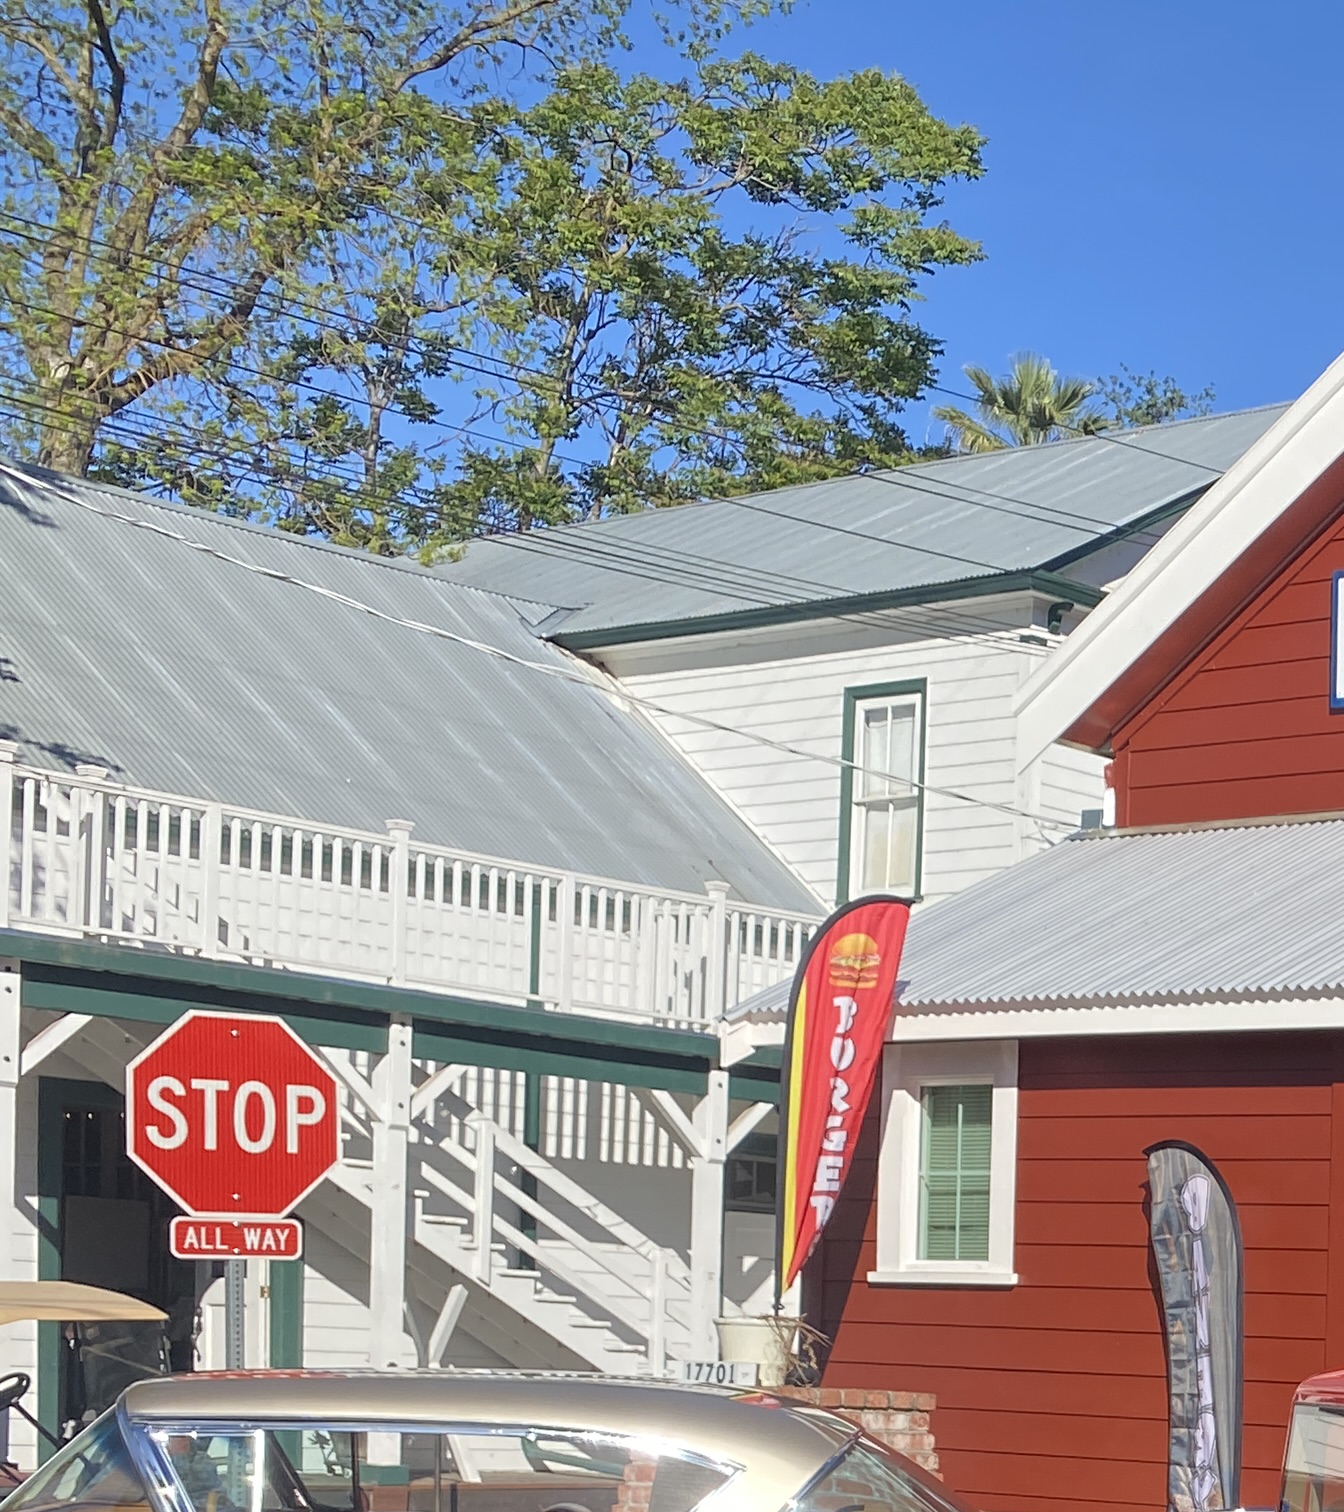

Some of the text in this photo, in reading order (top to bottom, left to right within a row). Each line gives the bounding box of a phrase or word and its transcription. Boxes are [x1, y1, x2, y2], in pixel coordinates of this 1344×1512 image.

[145, 1075, 327, 1155] STOP
[183, 1226, 291, 1251] ALL WAY
[686, 1362, 735, 1384] 17701
